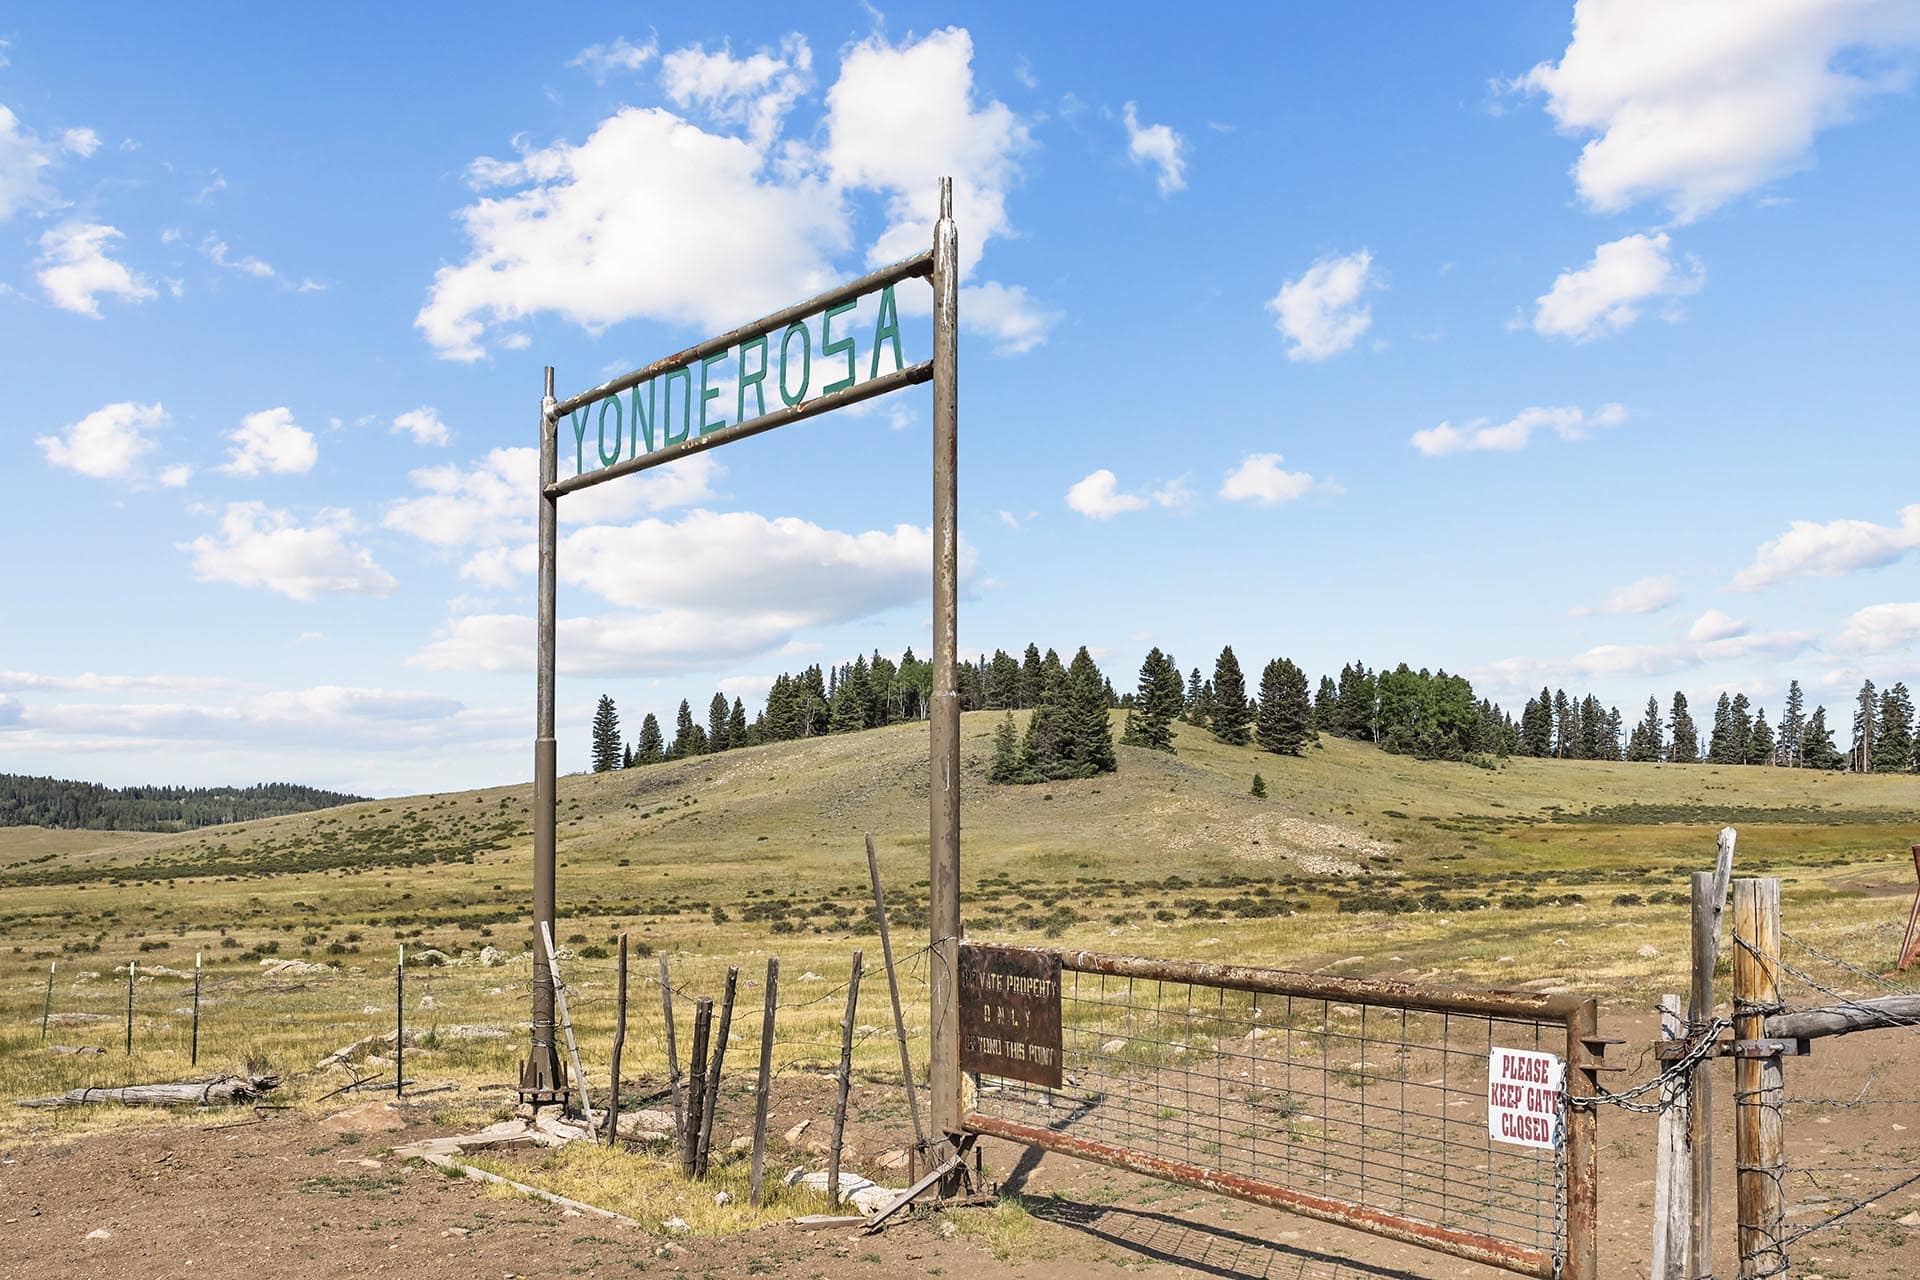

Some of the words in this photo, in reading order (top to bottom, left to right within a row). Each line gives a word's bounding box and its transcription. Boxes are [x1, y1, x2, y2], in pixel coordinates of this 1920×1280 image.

[570, 283, 905, 476] YONDEROSA
[962, 969, 1003, 993] PRVATE
[1006, 974, 1057, 997] PROPERTY
[1004, 1040, 1026, 1061] THIS
[1028, 1043, 1054, 1067] POINT
[1502, 1054, 1550, 1084] PLEASE
[1491, 1082, 1523, 1110] KEEP
[1527, 1087, 1560, 1115] GATE
[1501, 1112, 1550, 1143] CLOSED
